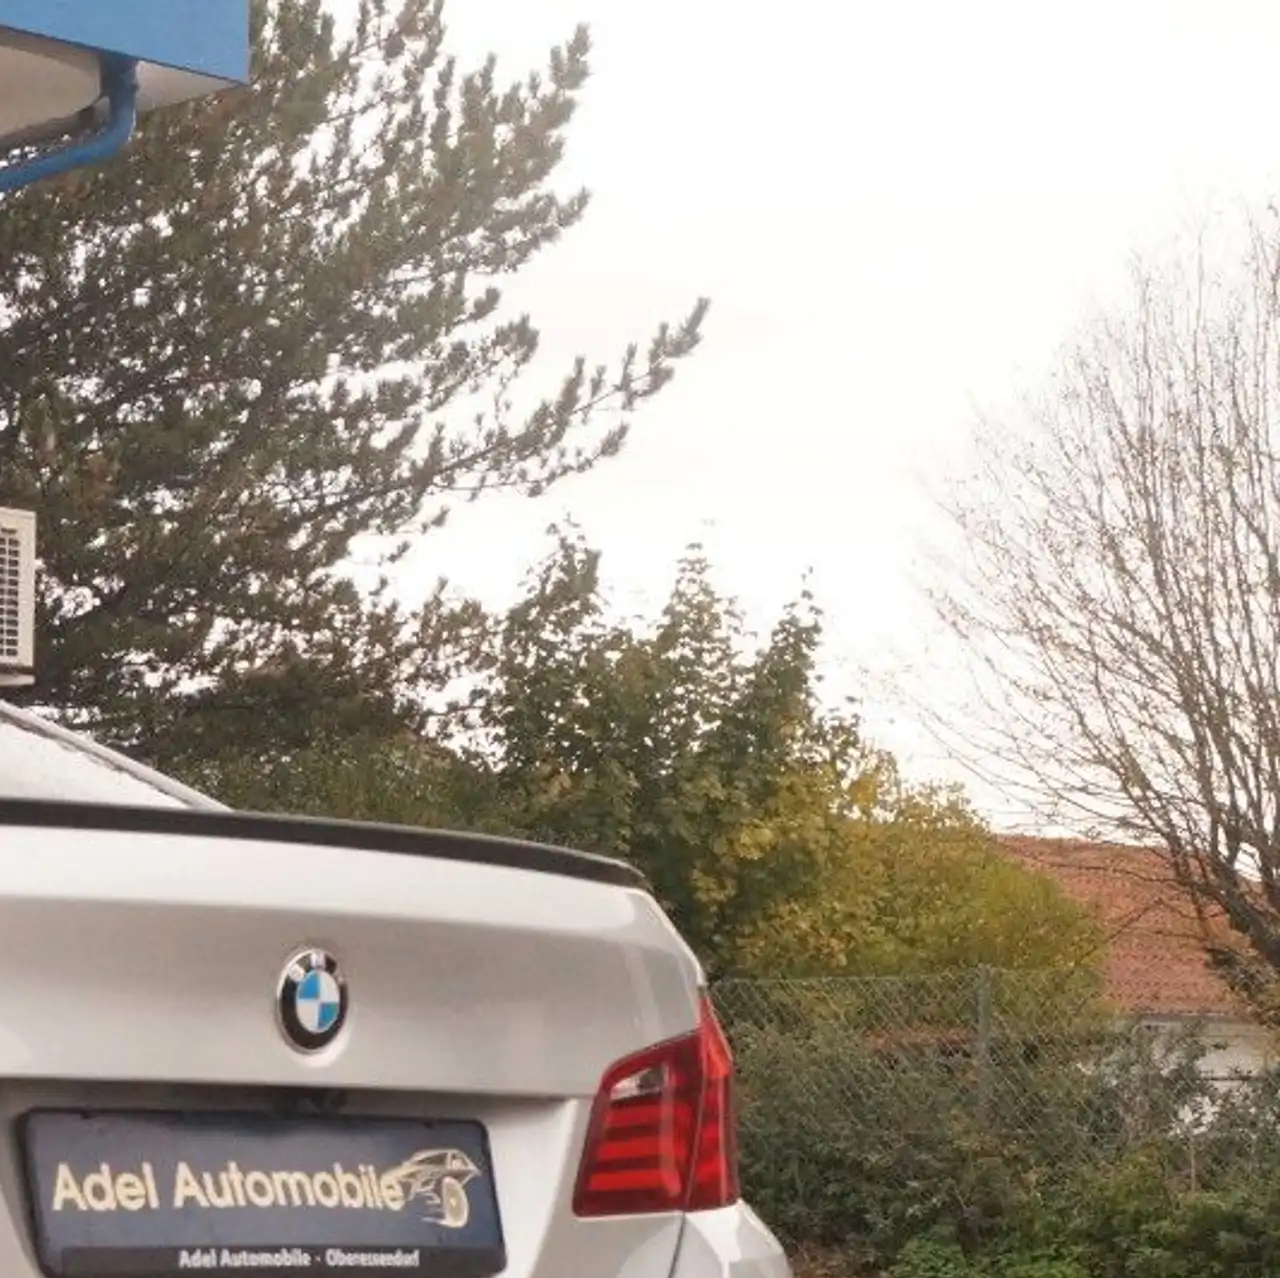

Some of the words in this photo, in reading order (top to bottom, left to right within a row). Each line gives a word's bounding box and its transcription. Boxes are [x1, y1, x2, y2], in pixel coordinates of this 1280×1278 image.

[52, 1161, 160, 1212] Adel
[172, 1160, 407, 1211] Automobile
[178, 1249, 217, 1269] Adel
[220, 1247, 312, 1268] Automobile
